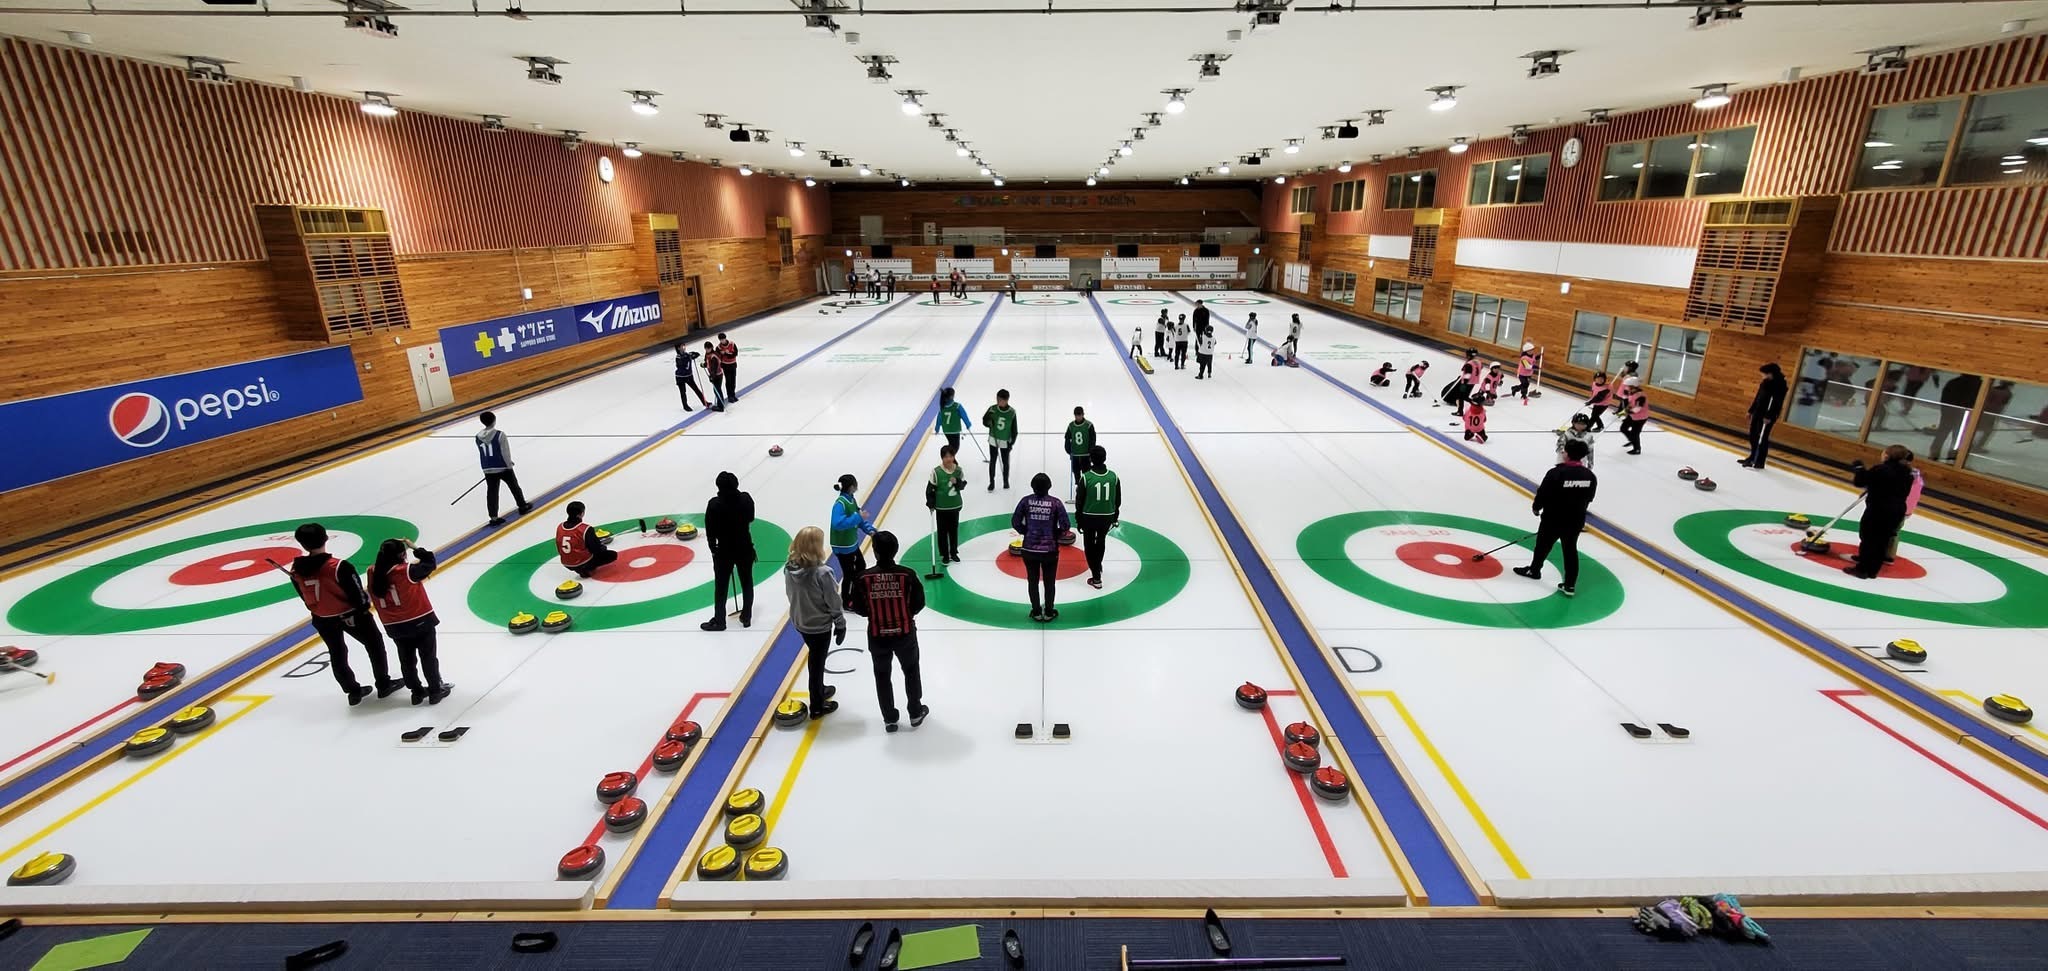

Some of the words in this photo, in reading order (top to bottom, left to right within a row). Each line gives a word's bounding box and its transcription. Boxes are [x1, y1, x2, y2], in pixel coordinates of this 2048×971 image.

[516, 318, 554, 339] サツドラ
[1207, 340, 1212, 349] 2
[174, 376, 271, 431] pepsi
[943, 412, 951, 425] 7
[998, 418, 1006, 430] 5
[1469, 415, 1480, 427] 10
[1075, 431, 1083, 445] 8
[479, 442, 494, 457] 11
[1094, 481, 1110, 501] 11
[561, 536, 572, 554] 5
[304, 579, 321, 602] 7
[281, 651, 330, 678] B
[824, 648, 864, 674] C
[1332, 646, 1383, 673] D
